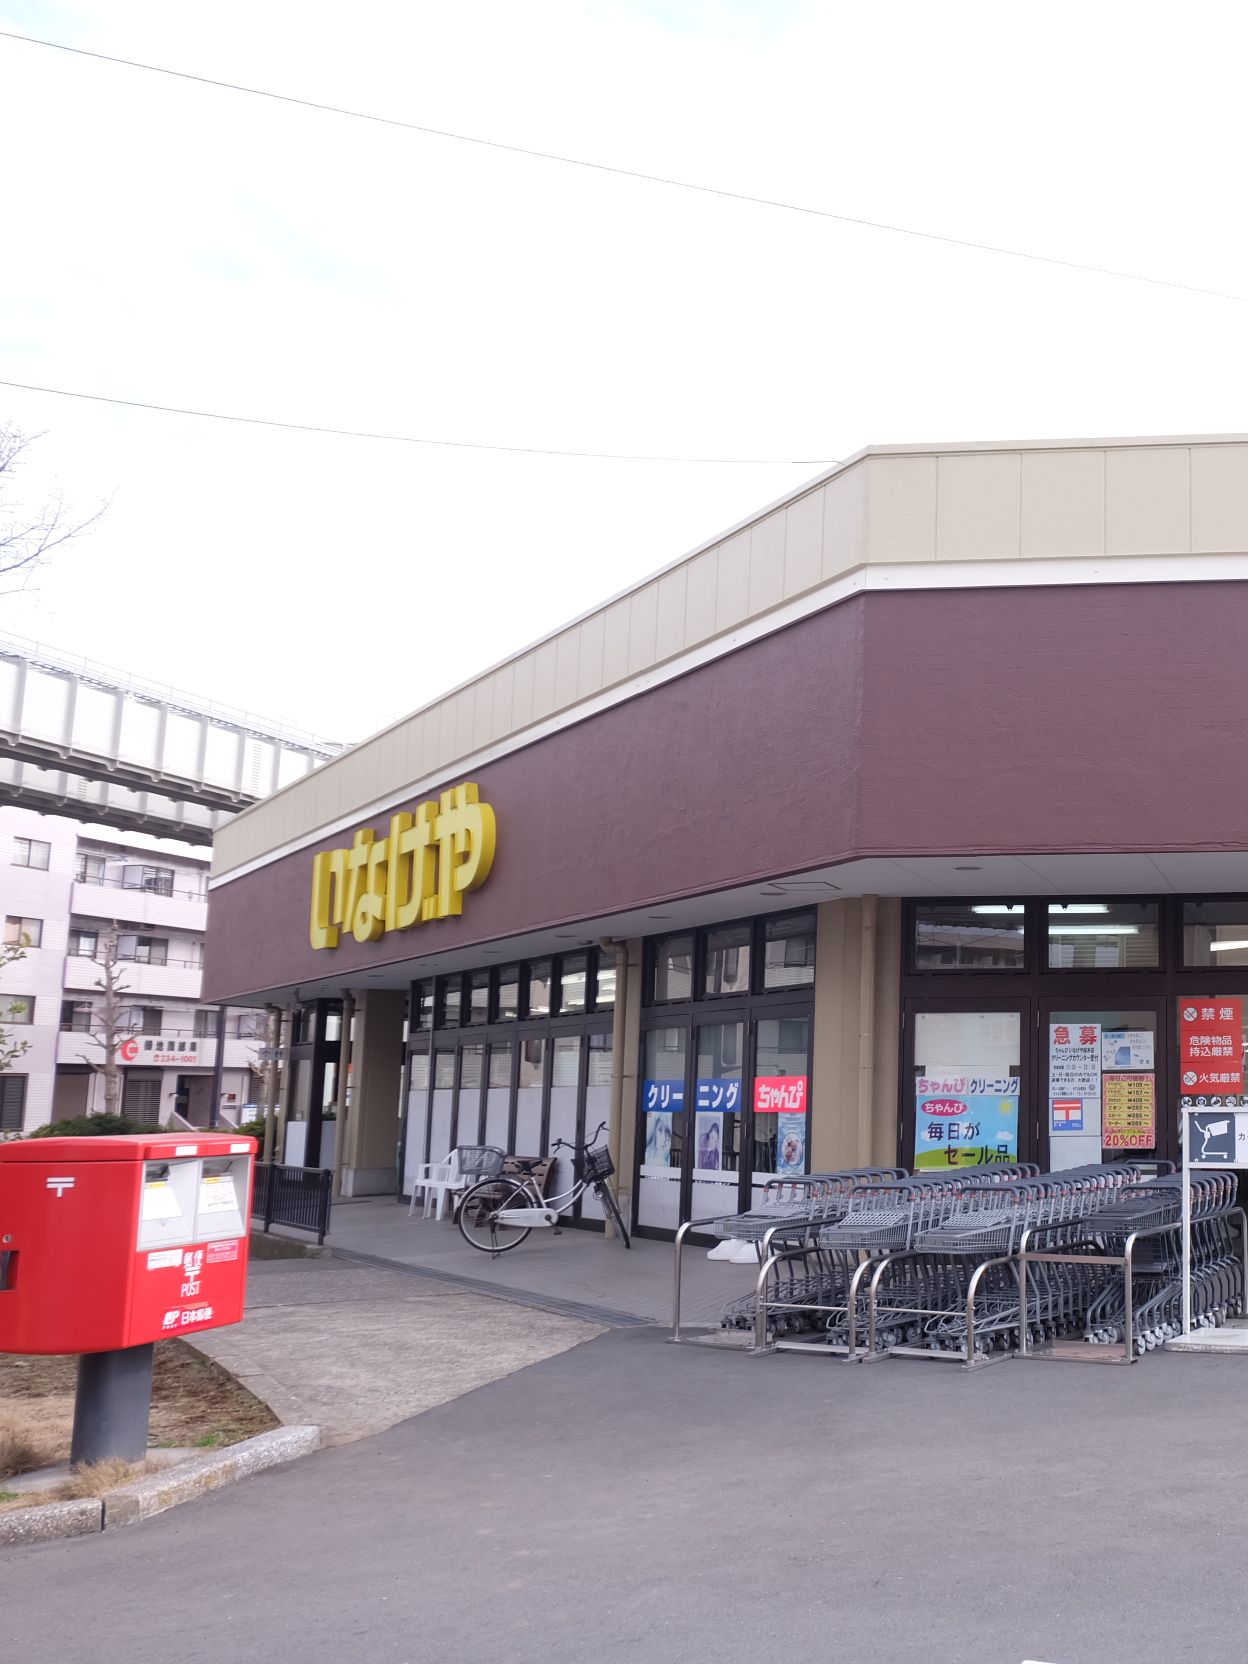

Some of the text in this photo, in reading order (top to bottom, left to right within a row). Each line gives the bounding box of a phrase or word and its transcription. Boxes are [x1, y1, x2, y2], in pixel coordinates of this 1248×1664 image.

[310, 782, 496, 950] いなげや
[1201, 1007, 1234, 1021] 禁煙
[1053, 1026, 1098, 1045] 急募
[1189, 1035, 1232, 1046] 危険物品
[1189, 1046, 1234, 1057] 持込厳禁
[1199, 1073, 1241, 1083] 火気厳禁
[757, 1080, 804, 1109] ちゃんぴ
[970, 1079, 1018, 1094] クリーニング
[927, 1121, 981, 1141] 毎日が
[1105, 1134, 1153, 1147] 20%OFF
[944, 1144, 1010, 1165] セール品
[180, 1281, 200, 1298] POST
